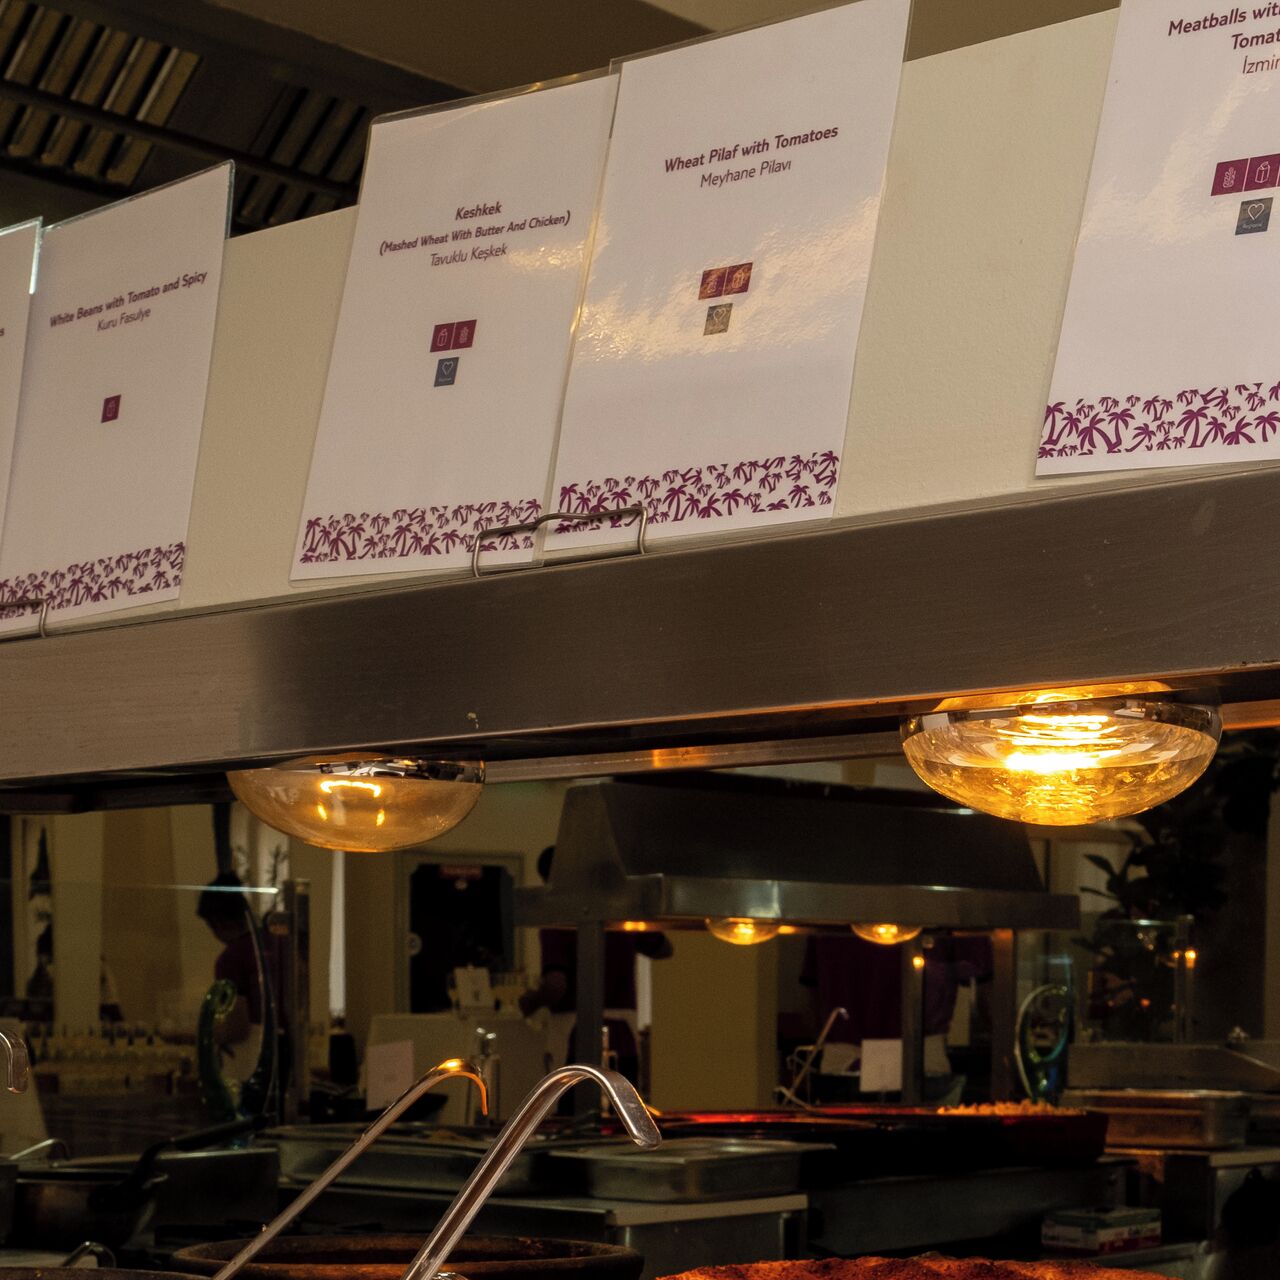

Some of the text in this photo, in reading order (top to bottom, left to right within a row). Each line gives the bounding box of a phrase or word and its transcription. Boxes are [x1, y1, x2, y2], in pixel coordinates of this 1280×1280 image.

[1167, 8, 1247, 37] Meatballs
[664, 126, 839, 173] Wheat Pilaf with Tomatoes
[700, 167, 756, 189] Meyhane
[454, 201, 503, 221] Keshkek
[379, 210, 571, 256] (Mashed Wheat With Butter And Chicken)
[430, 243, 508, 267] Tavuklu Keşkek
[50, 271, 208, 328] White Beans with Tomato and Spicy
[97, 308, 151, 331] Kuru Fasulye
